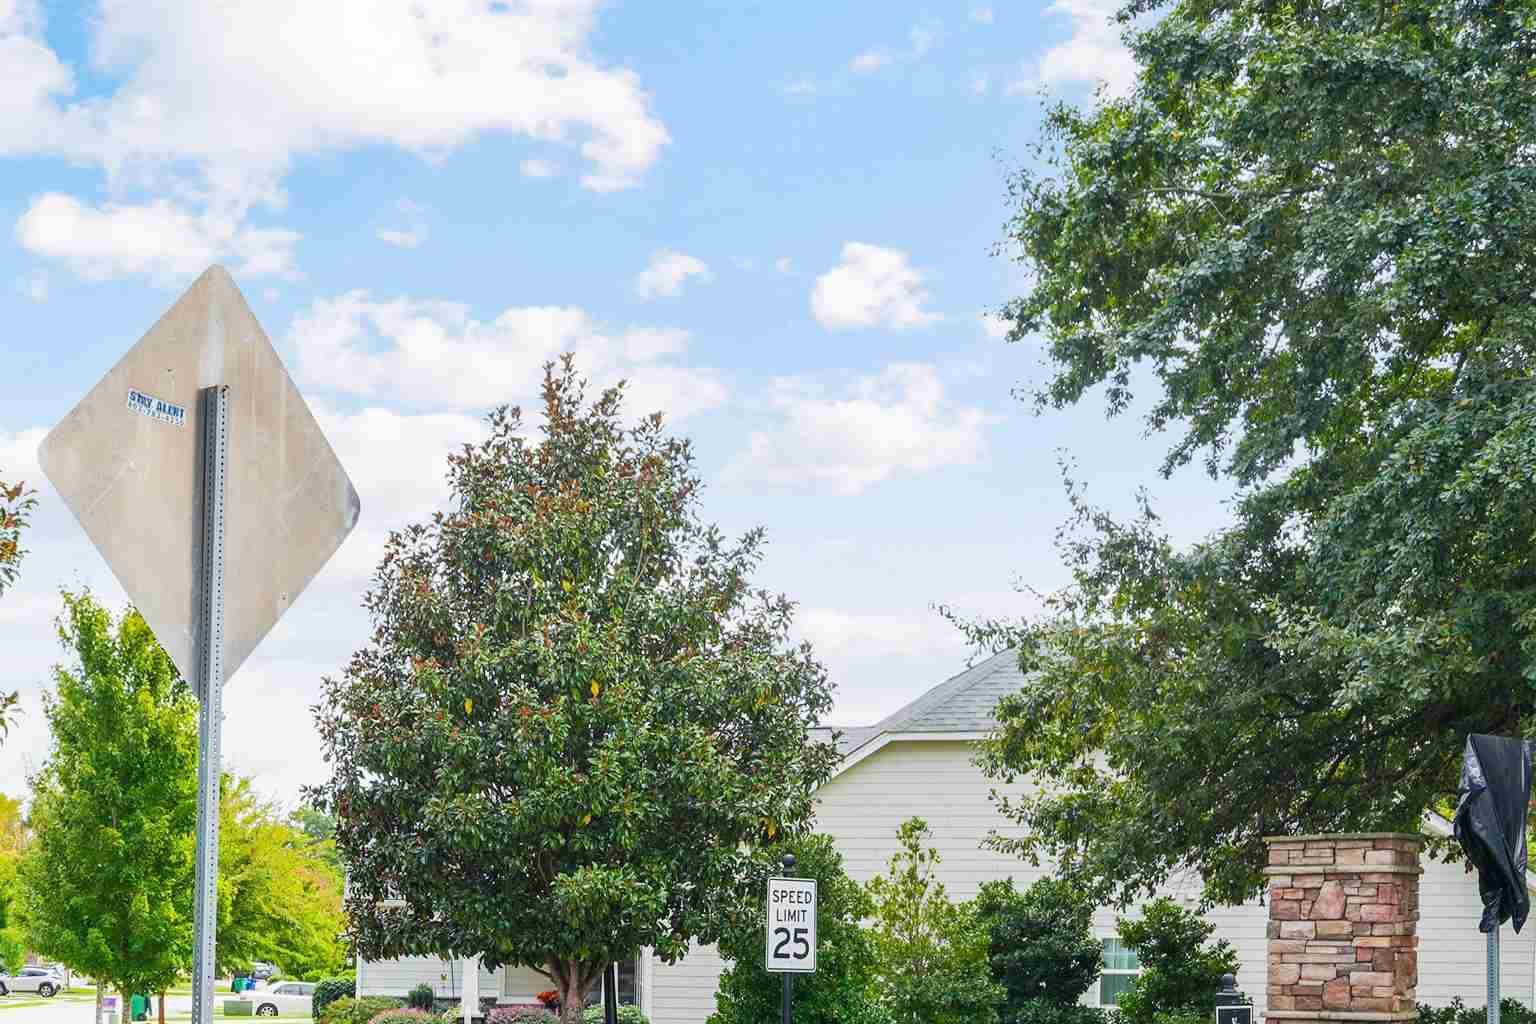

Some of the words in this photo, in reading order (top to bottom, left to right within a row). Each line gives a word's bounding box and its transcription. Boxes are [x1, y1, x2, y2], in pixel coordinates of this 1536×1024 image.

[772, 890, 812, 904] SPEED
[776, 909, 807, 922] LIMIT
[773, 927, 809, 959] 25
